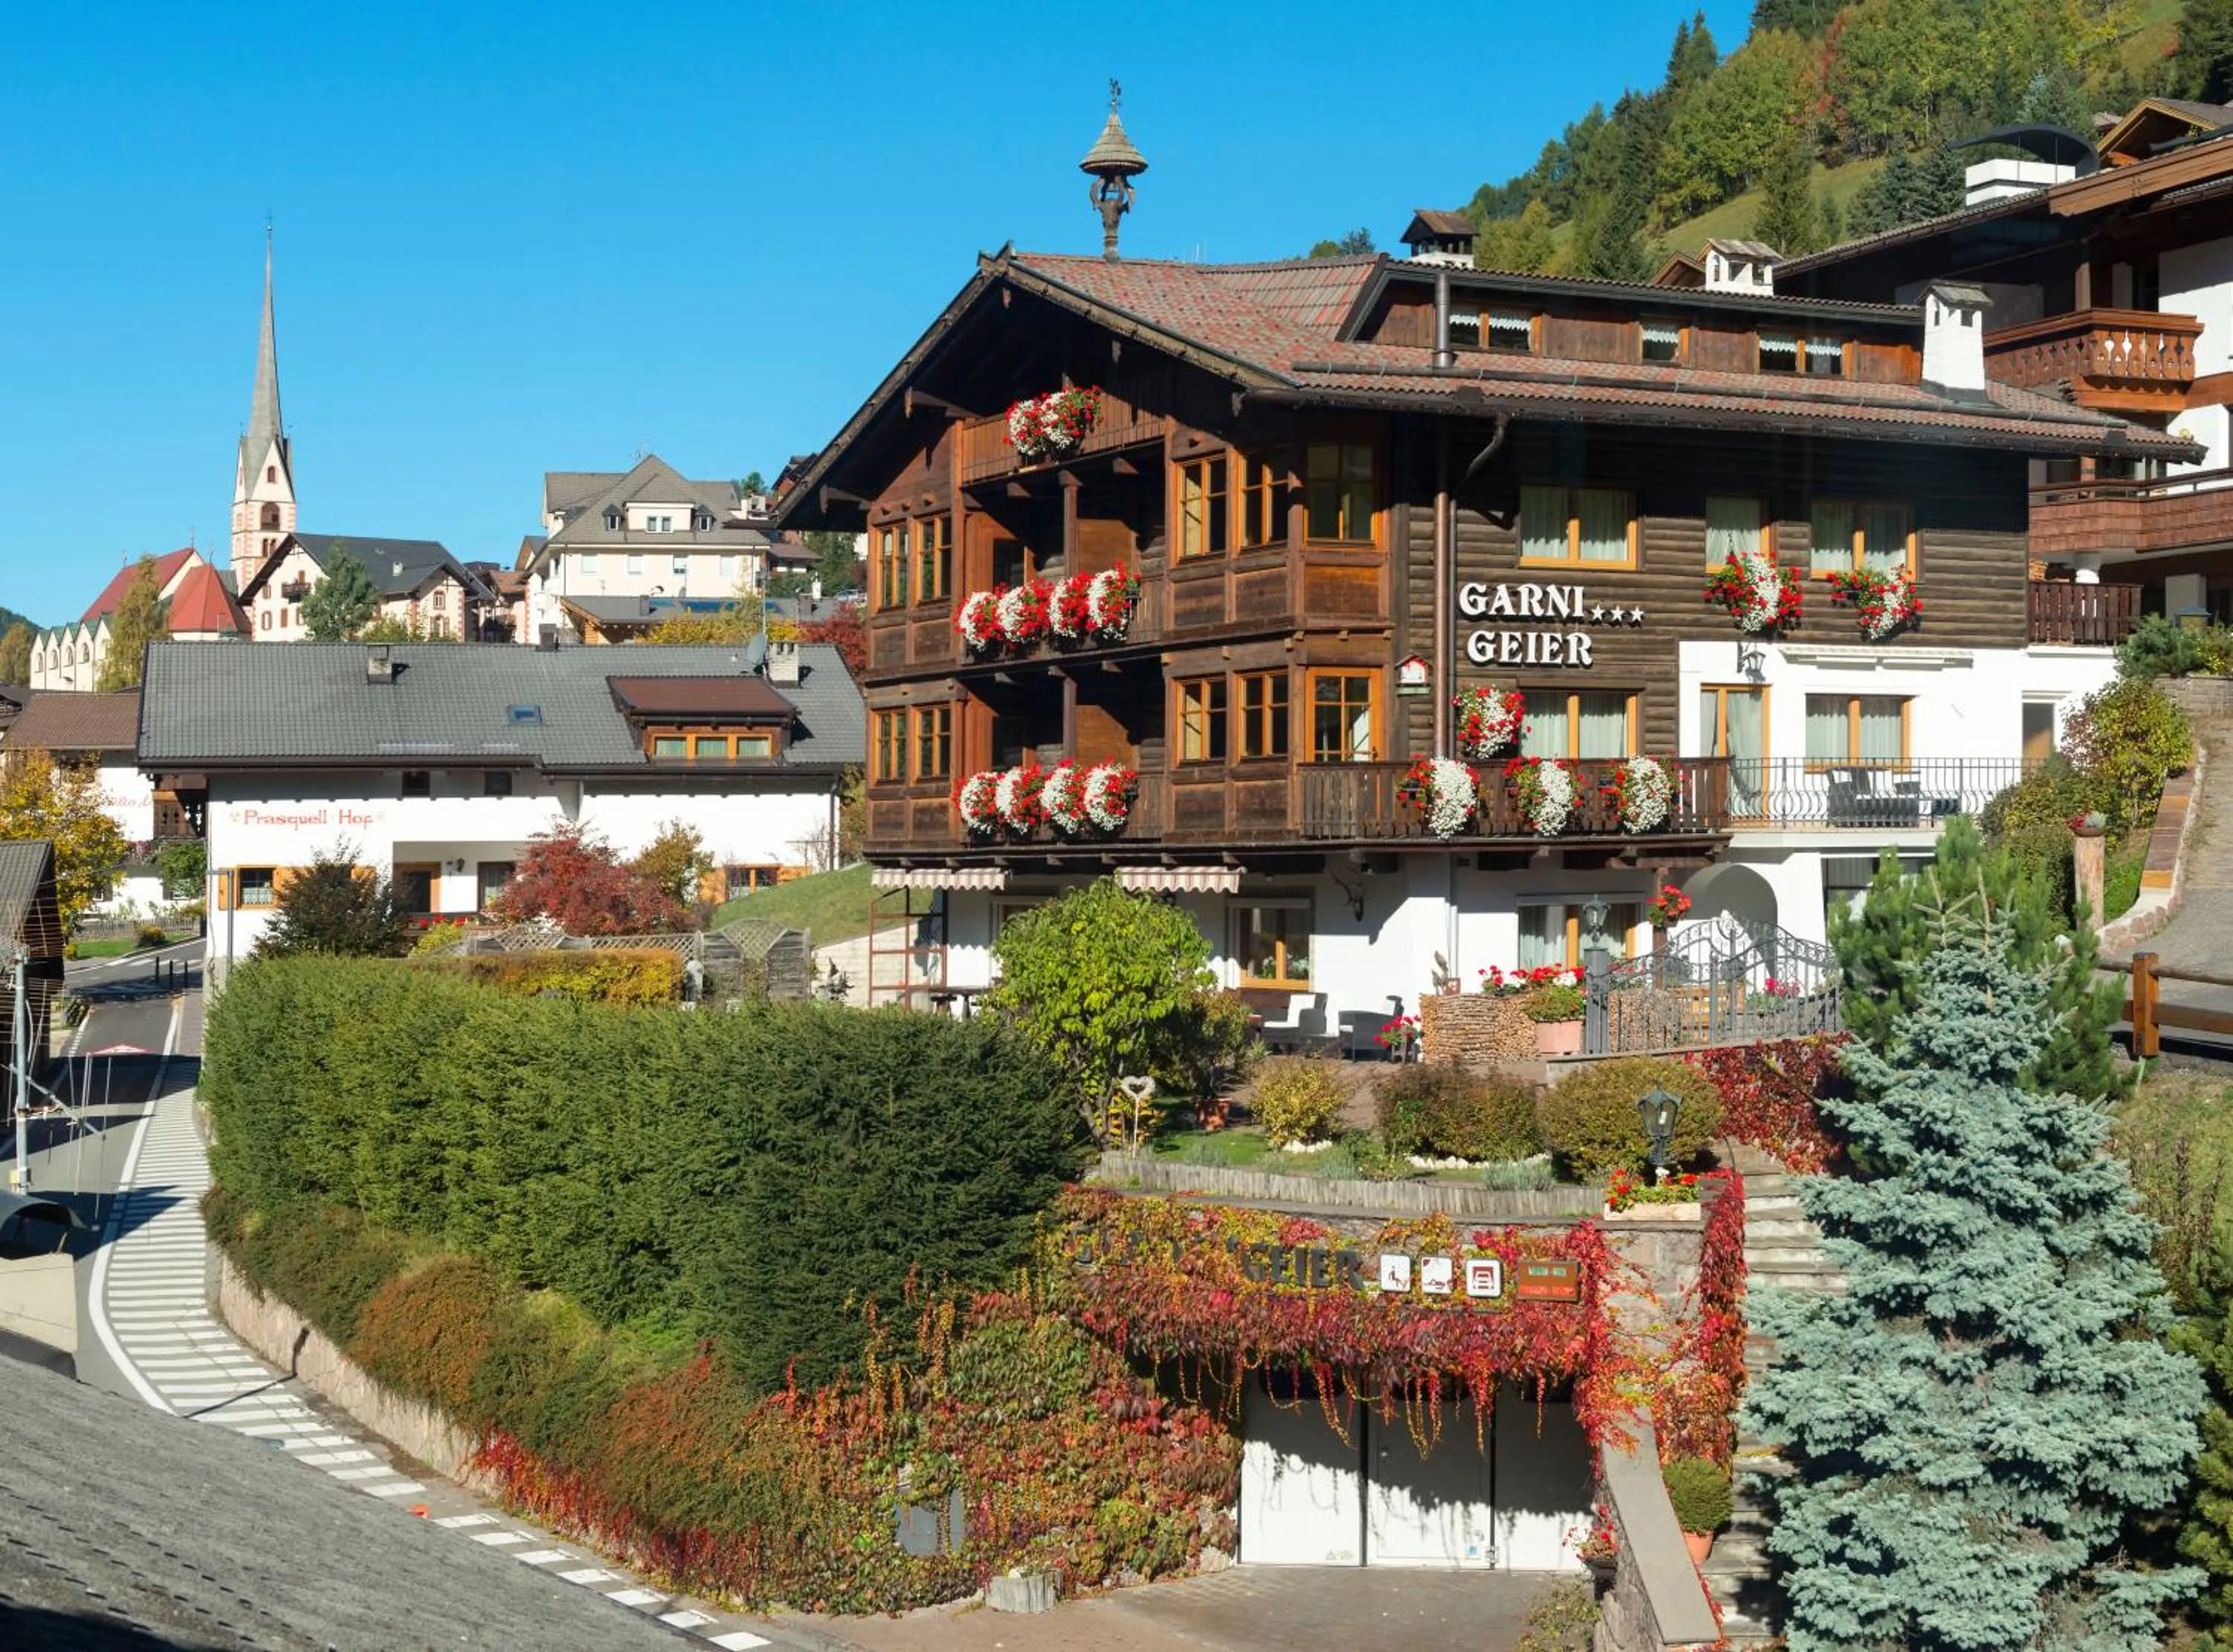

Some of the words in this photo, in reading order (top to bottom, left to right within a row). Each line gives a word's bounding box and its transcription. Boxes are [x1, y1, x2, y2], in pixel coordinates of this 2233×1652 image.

[1459, 583, 1585, 618] GARNI
[1467, 630, 1593, 666] GEIER
[244, 809, 327, 830] Prasquell
